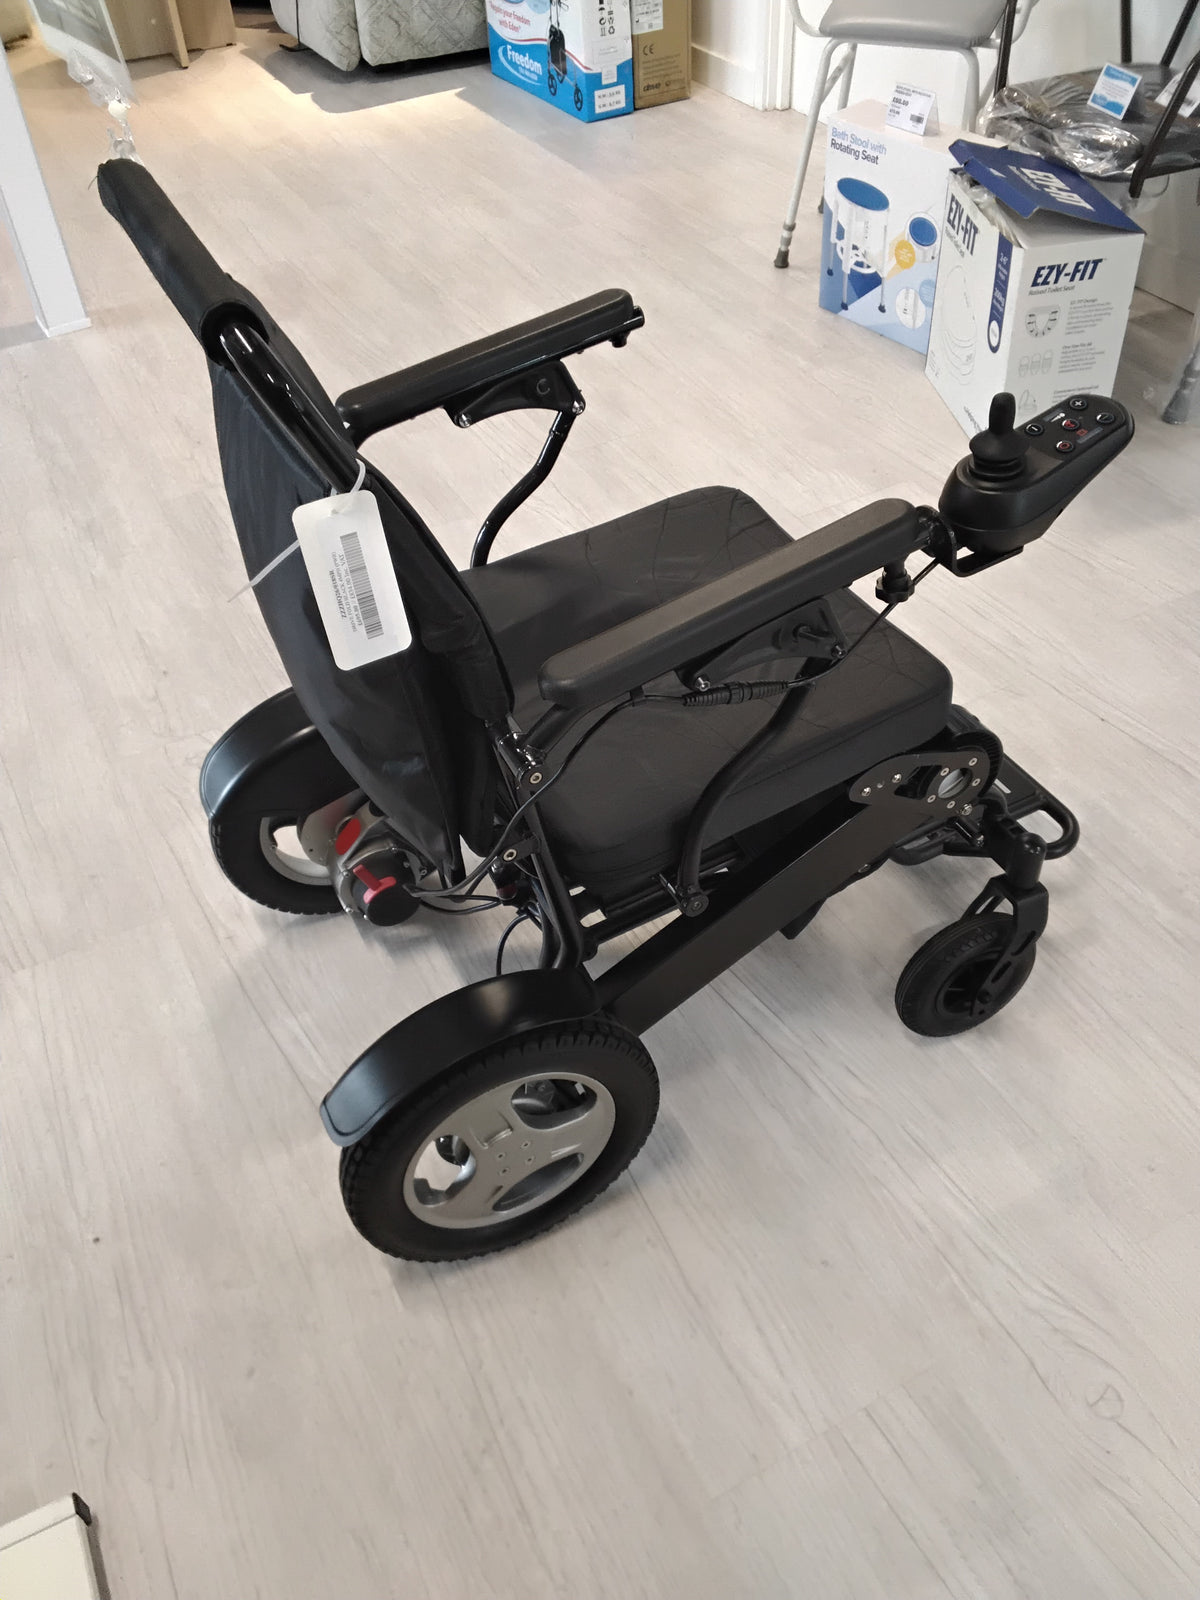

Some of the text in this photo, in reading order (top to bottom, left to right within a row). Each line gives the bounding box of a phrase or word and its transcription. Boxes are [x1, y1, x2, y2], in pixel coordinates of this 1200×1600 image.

[506, 44, 543, 75] Freedom
[830, 138, 879, 165] Rotating Seat
[831, 127, 887, 155] Bath Stool with
[1020, 167, 1096, 212] EZY-FIT
[946, 193, 979, 256] EZY-FIT
[1030, 258, 1104, 288] EZY-FIT
[1028, 284, 1076, 297] Raised Toilet Seat
[338, 552, 347, 566] VAT
